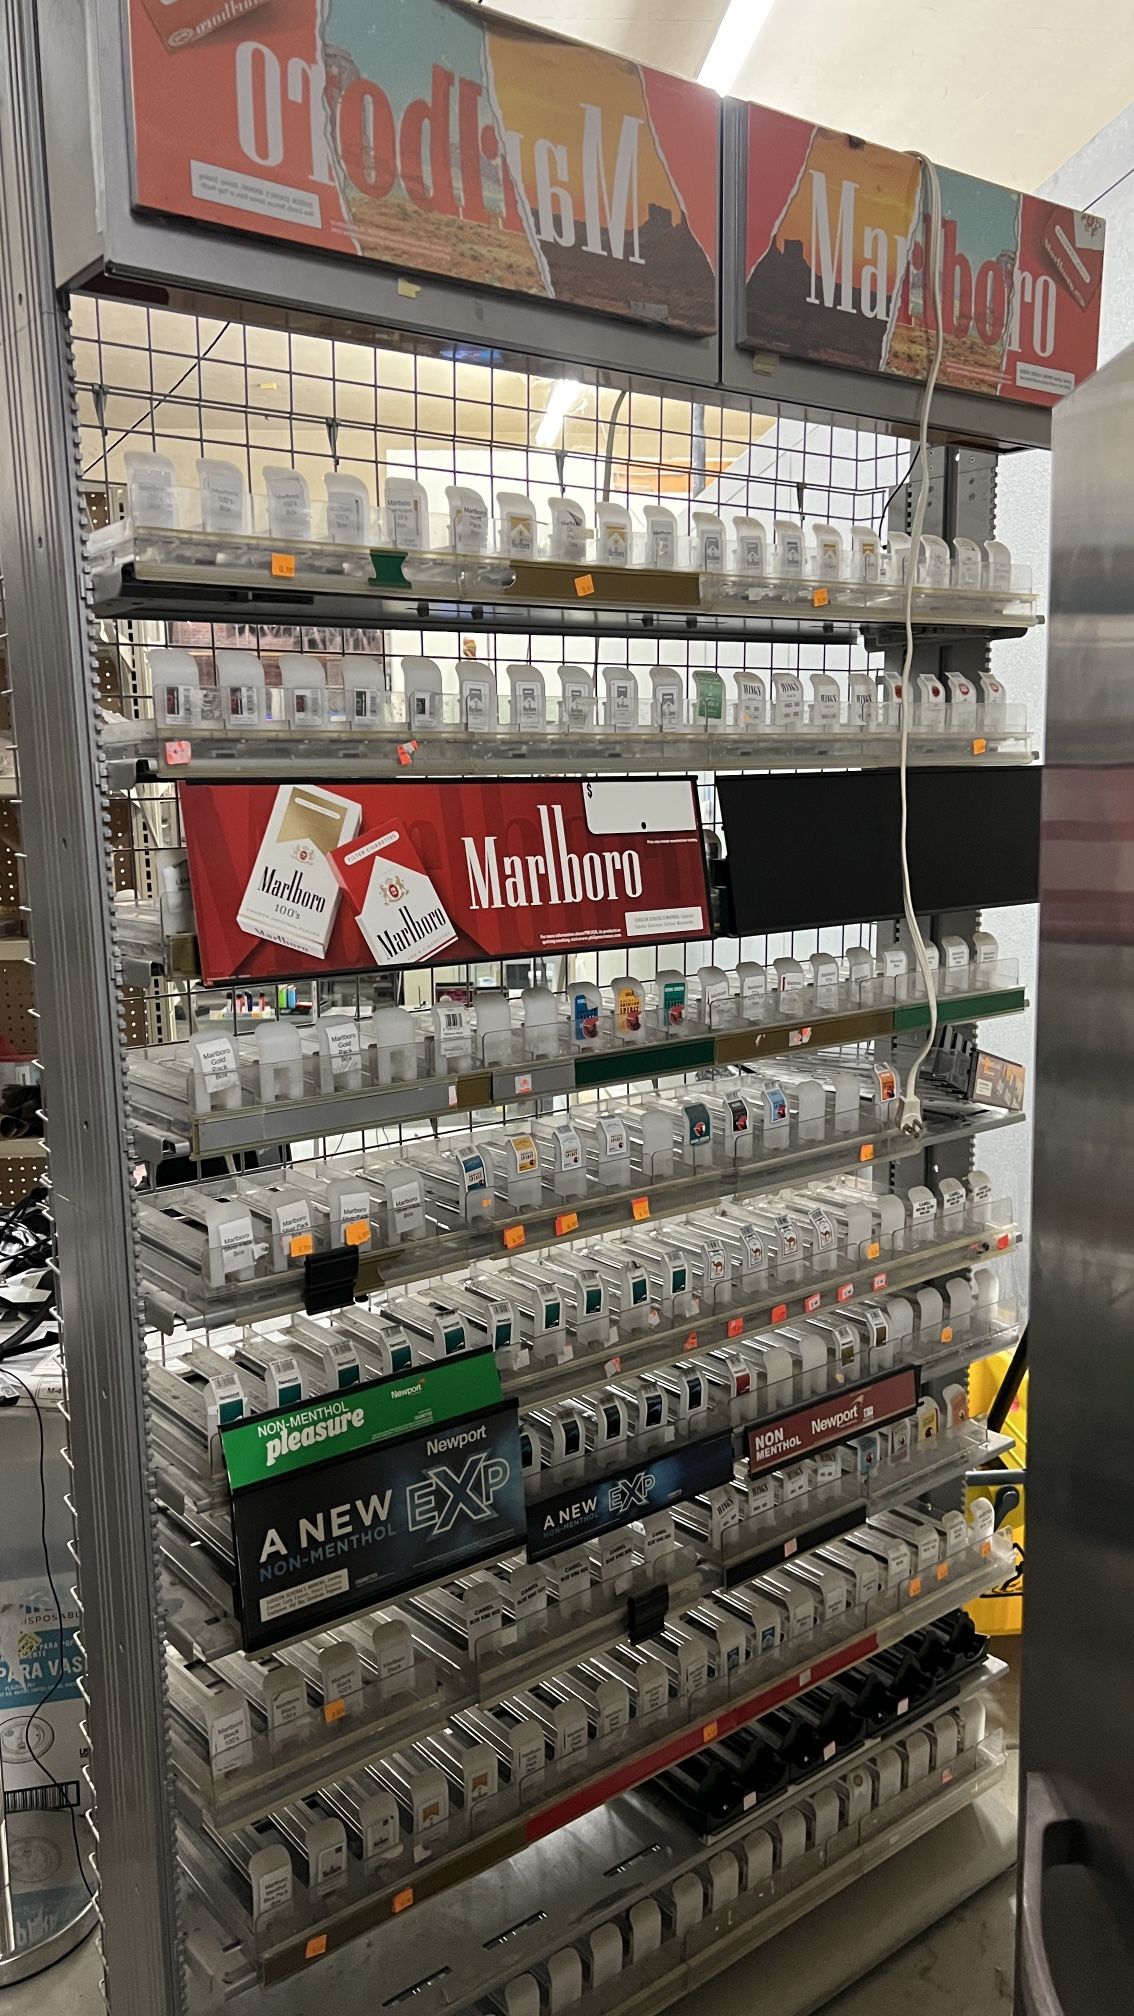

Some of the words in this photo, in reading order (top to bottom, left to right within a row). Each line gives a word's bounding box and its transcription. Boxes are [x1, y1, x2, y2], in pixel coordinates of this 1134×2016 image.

[806, 169, 1056, 358] Marlboro
[461, 804, 643, 910] Marlboro
[257, 865, 326, 913] Marlboro
[274, 903, 301, 920] 100's
[377, 905, 446, 960] Marlboro
[331, 1033, 357, 1042] Marlboro
[338, 1041, 351, 1049] Gold
[203, 1048, 231, 1060] Marlboro
[211, 1057, 226, 1066] Gold
[396, 1196, 418, 1206] Marlboro
[343, 1207, 367, 1215] Marlboro
[282, 1216, 307, 1227] Marlboro
[224, 1233, 250, 1244] Marlboro
[391, 1384, 422, 1399] Newport
[257, 1401, 350, 1438] NON-MENTHOL
[811, 1407, 858, 1435] Newport
[265, 1407, 365, 1467] pleasure
[426, 1424, 487, 1456] Newport
[755, 1428, 784, 1450] NON
[756, 1435, 802, 1462] MENTHOL
[259, 1528, 288, 1563] A
[298, 1489, 393, 1549] NEW
[406, 1451, 510, 1536] EXP
[543, 1515, 555, 1531] A
[559, 1496, 598, 1524] NEW
[608, 1471, 656, 1512] EXP
[259, 1522, 397, 1583] NON-MENTHOL
[24, 1611, 79, 1625] ISPOSABL
[474, 1604, 493, 1616] CAMEL
[48, 1655, 83, 1677] VAS
[217, 1720, 244, 1735] Marlboro
[223, 1729, 239, 1740] Black
[264, 1876, 288, 1890] Marlboro
